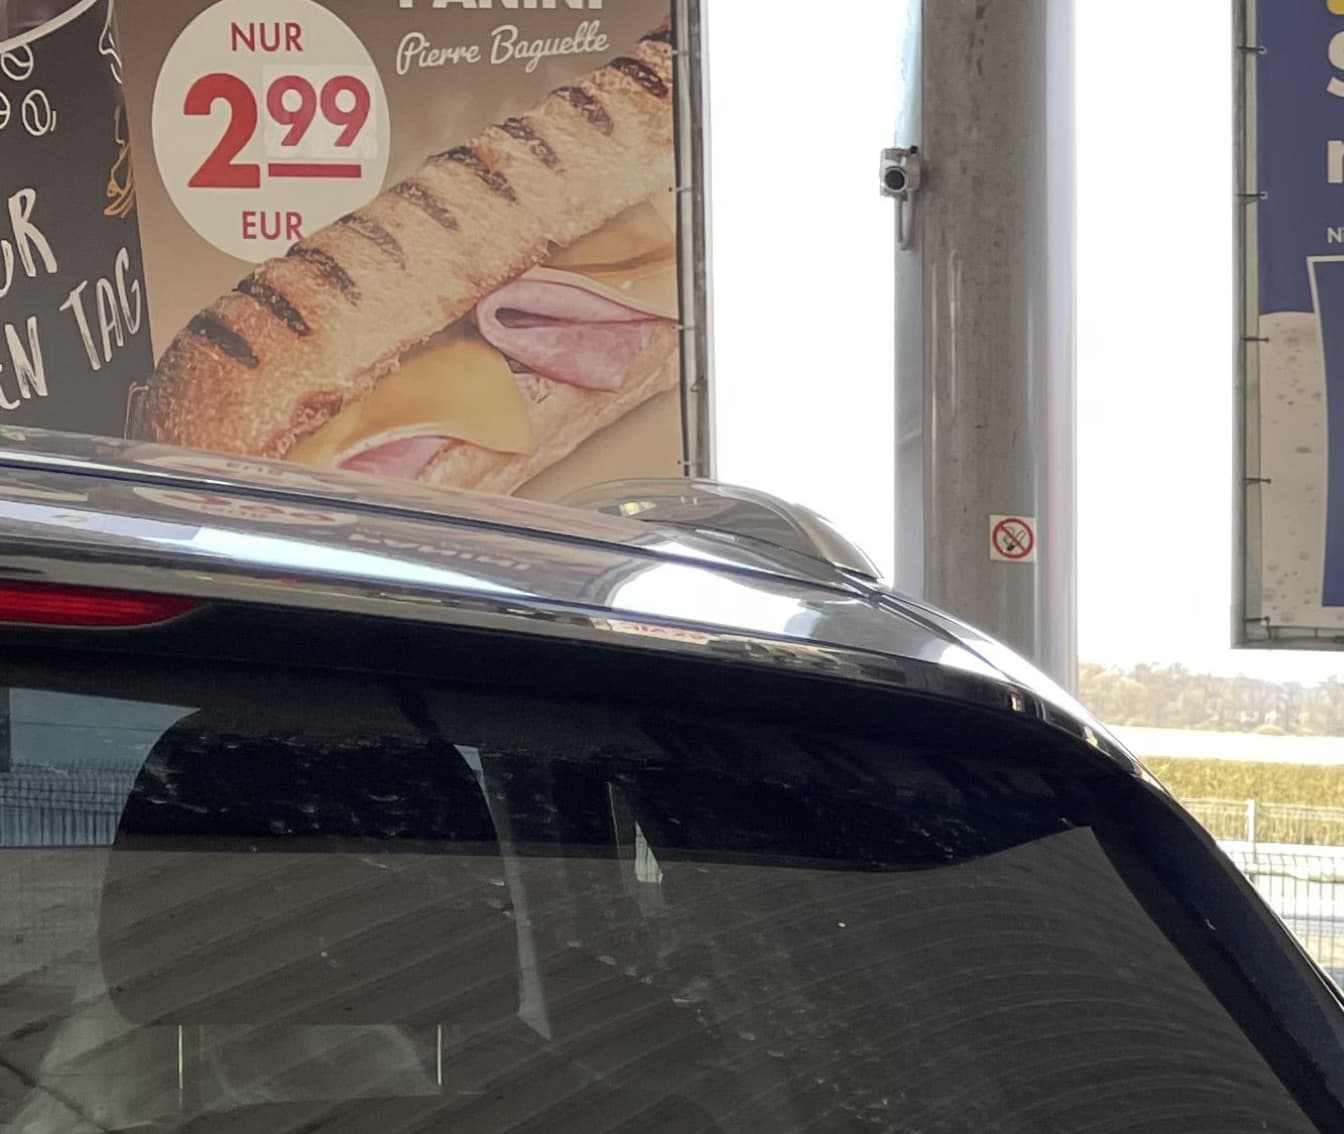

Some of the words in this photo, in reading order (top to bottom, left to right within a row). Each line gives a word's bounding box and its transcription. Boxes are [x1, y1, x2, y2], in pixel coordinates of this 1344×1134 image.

[230, 21, 304, 53] NUR
[396, 32, 482, 75] Pierre
[490, 20, 610, 73] Baguette
[241, 210, 304, 241] EUR
[59, 247, 142, 370] TAG
